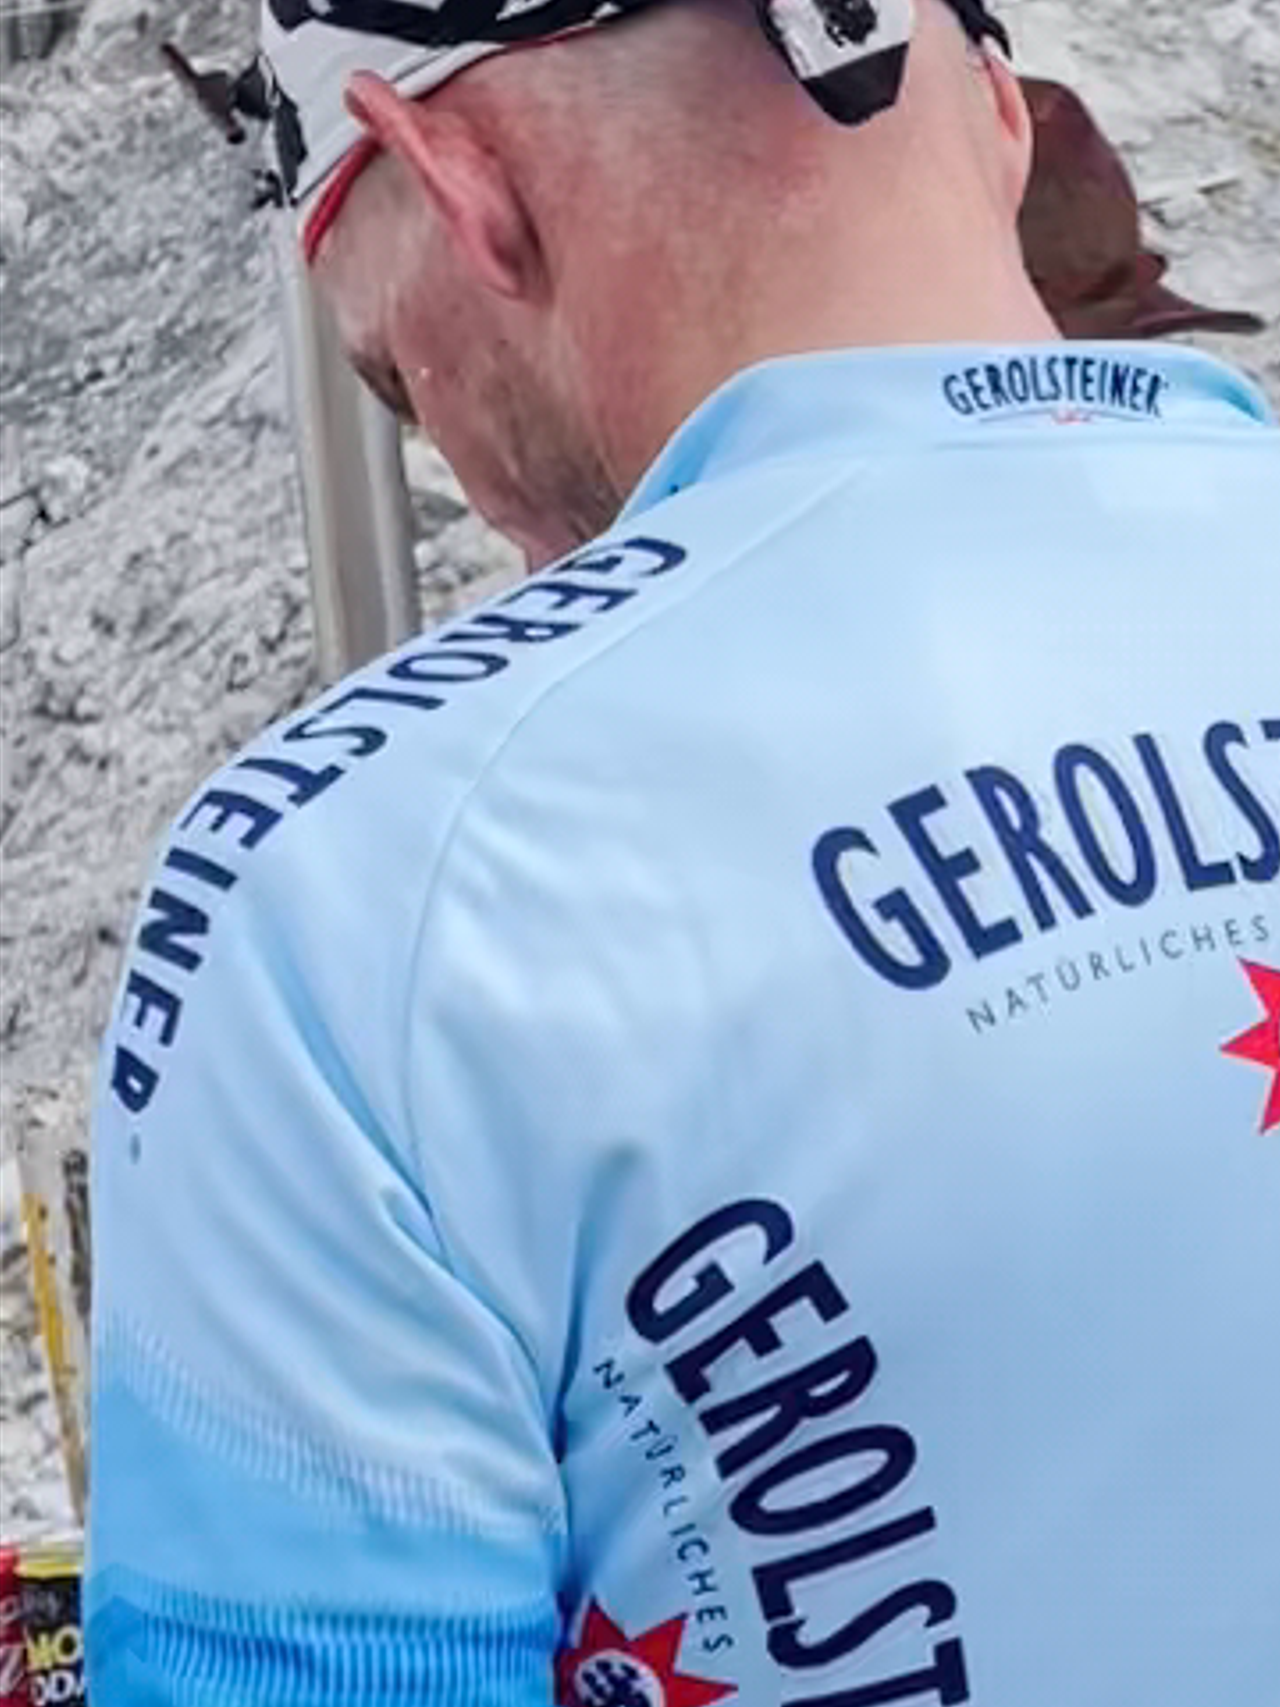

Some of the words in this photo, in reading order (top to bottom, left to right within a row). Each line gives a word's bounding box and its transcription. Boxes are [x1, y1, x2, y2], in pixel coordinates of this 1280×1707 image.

[943, 355, 1164, 419] GEROLSTEINER
[965, 915, 1273, 1035] NATÜRLICHES
[595, 1357, 735, 1655] NATÜRLICHES
